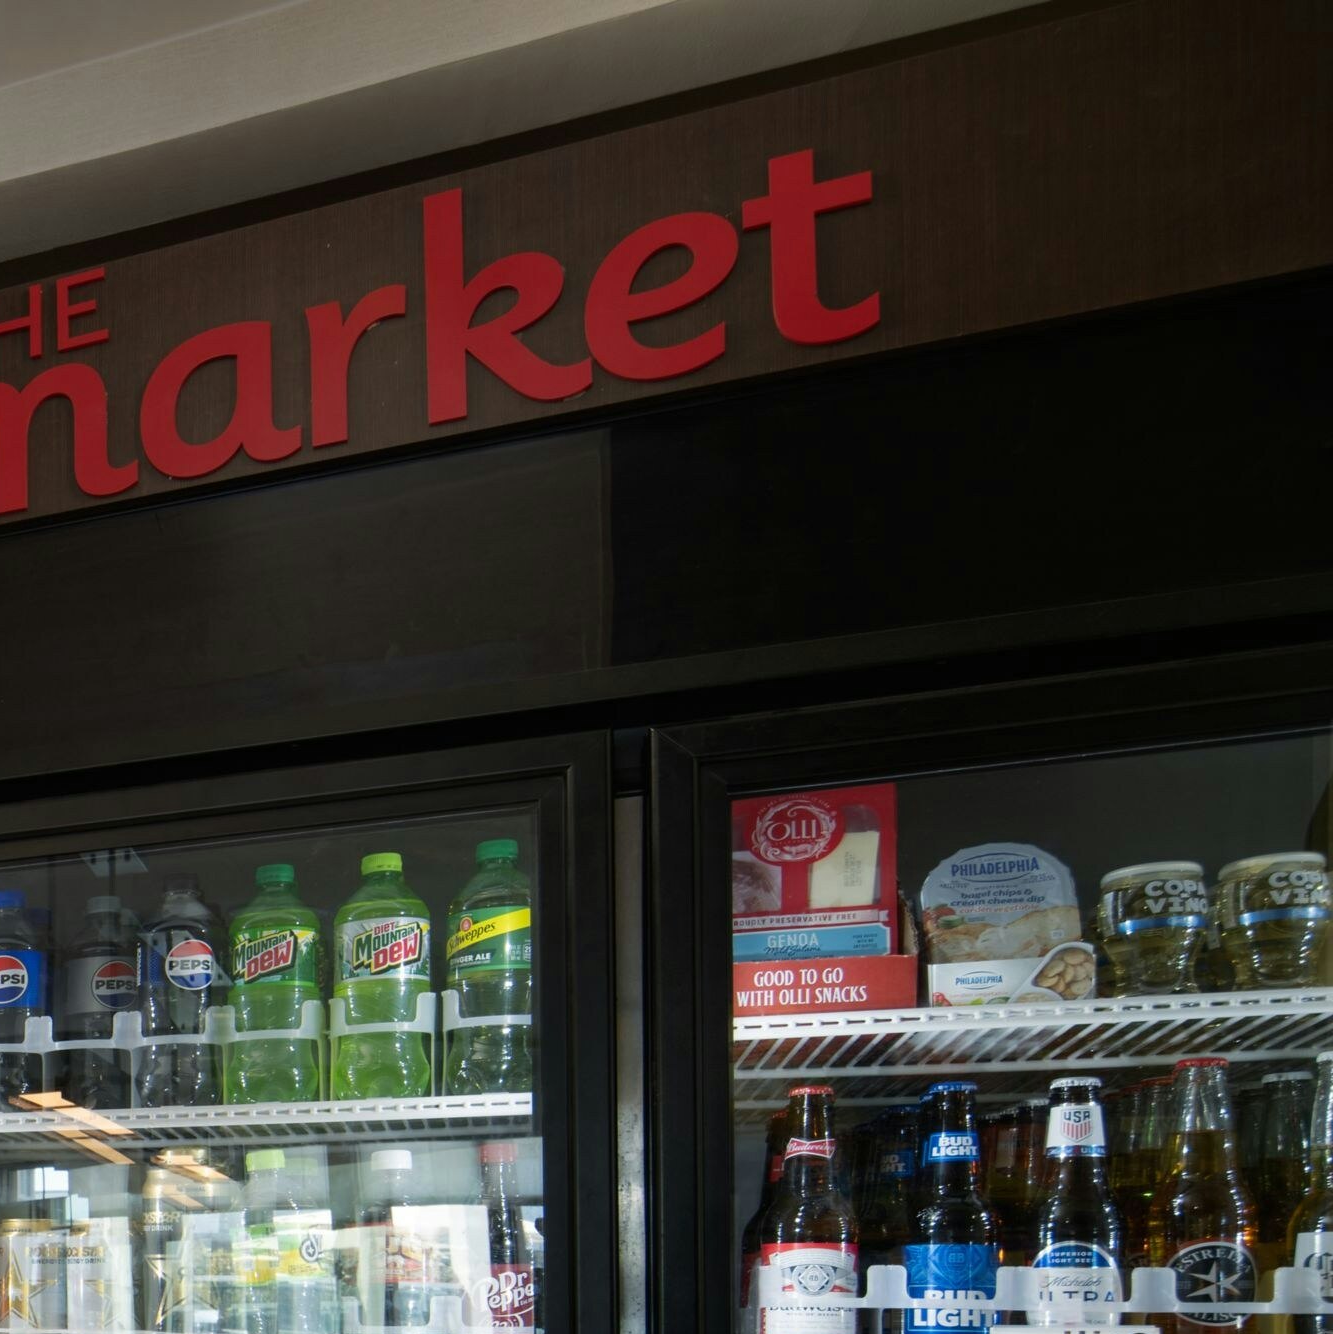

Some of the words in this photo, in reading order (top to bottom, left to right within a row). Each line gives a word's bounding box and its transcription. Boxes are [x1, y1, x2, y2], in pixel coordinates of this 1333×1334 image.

[766, 819, 817, 843] OLLI
[951, 856, 1040, 878] PHILADELPHIA
[834, 911, 858, 921] FREE
[373, 922, 395, 936] DIET
[354, 927, 416, 963] MOUNTAIN
[766, 933, 820, 949] GENOA
[234, 933, 288, 973] MOUNTAIN
[245, 942, 294, 979] DEW
[373, 935, 421, 973] DEW
[474, 952, 492, 963] ALE
[754, 970, 794, 988] GOOD
[799, 969, 816, 986] TO
[819, 968, 844, 984] GO
[955, 974, 1003, 987] PHILADELPHIA
[737, 989, 775, 1007] WITH
[778, 988, 811, 1006] OLLI
[814, 984, 868, 1005] SNACKS
[1063, 1110, 1093, 1124] USA
[933, 1144, 979, 1158] LIGHT
[939, 1134, 973, 1148] BUD
[1047, 1256, 1072, 1264] LIGHT
[499, 1271, 529, 1294] Dr
[913, 1308, 995, 1328] LIGHT
